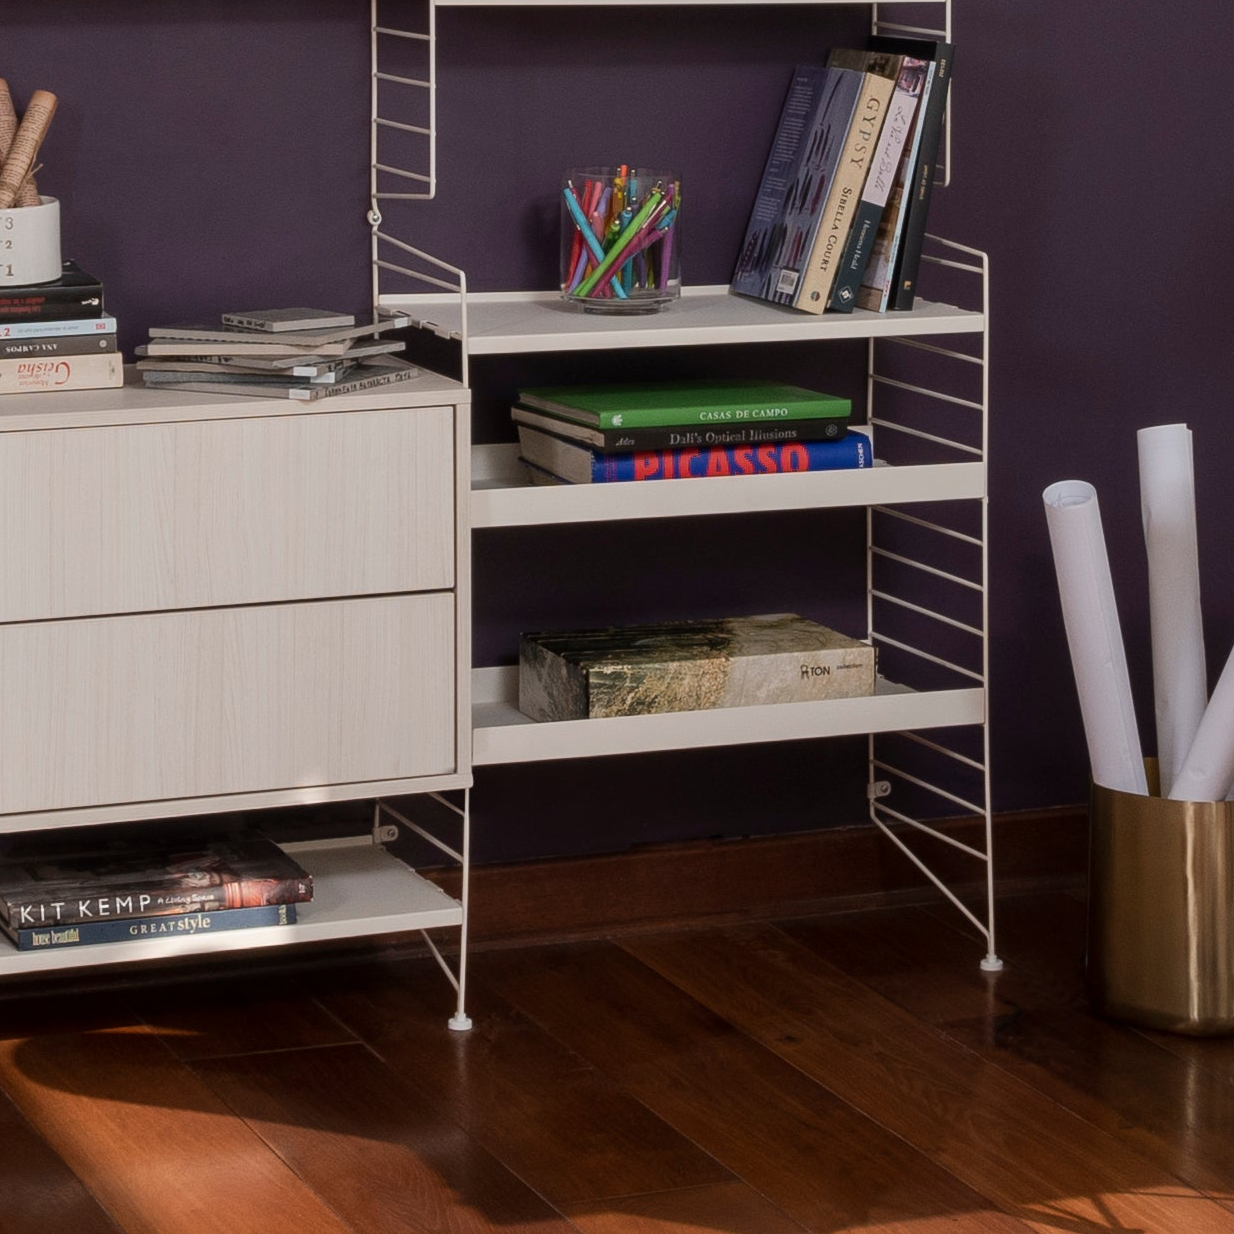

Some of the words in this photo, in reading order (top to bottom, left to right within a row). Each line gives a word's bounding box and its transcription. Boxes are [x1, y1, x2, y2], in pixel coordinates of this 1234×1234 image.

[850, 97, 881, 170] GYPSY
[4, 217, 14, 230] 3
[5, 240, 13, 250] 2
[5, 264, 14, 277] 1
[5, 344, 37, 354] CAMPOS
[40, 342, 59, 352] ANA
[17, 361, 71, 386] Geisha
[699, 411, 731, 421] CASAS
[735, 409, 750, 419] DE
[752, 407, 788, 418] CAMPO
[706, 429, 748, 446] Optical
[749, 427, 797, 443] Illusions
[634, 442, 810, 481] PICASSO
[19, 901, 66, 924] KIT
[78, 894, 152, 919] KEMP
